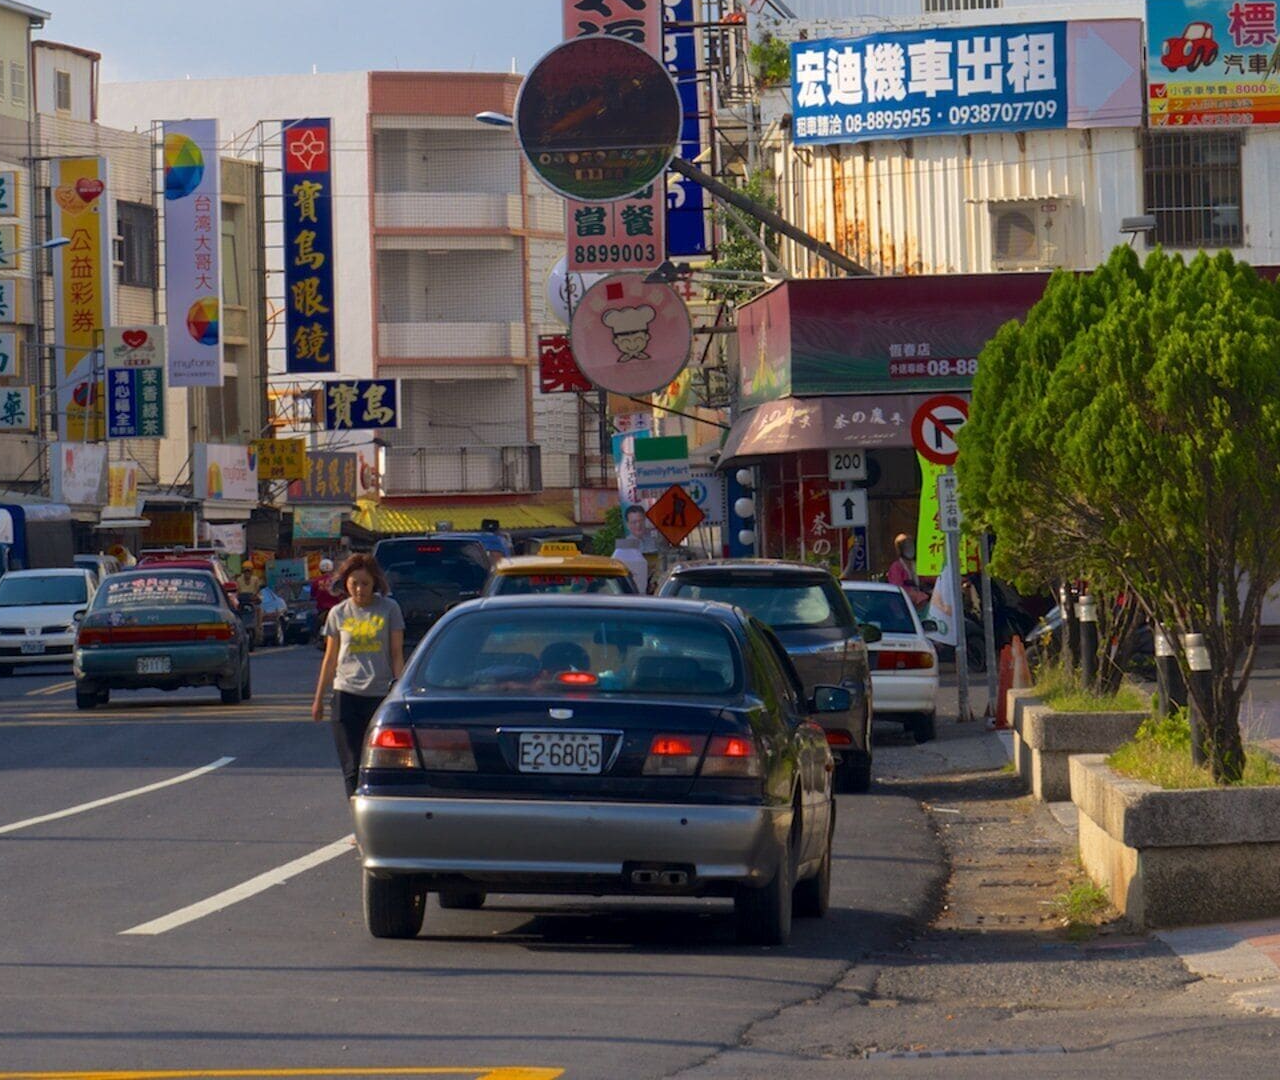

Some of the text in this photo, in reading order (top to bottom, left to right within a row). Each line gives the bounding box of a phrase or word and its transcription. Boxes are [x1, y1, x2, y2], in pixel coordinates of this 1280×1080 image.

[795, 32, 1057, 108] 宏迪機車出租
[845, 107, 931, 133] 08-8895955
[948, 100, 1058, 125] 0938707709
[575, 244, 656, 264] 8899003
[70, 228, 95, 334] 公益彩券
[327, 384, 394, 427] 寶島
[834, 454, 861, 470] 200
